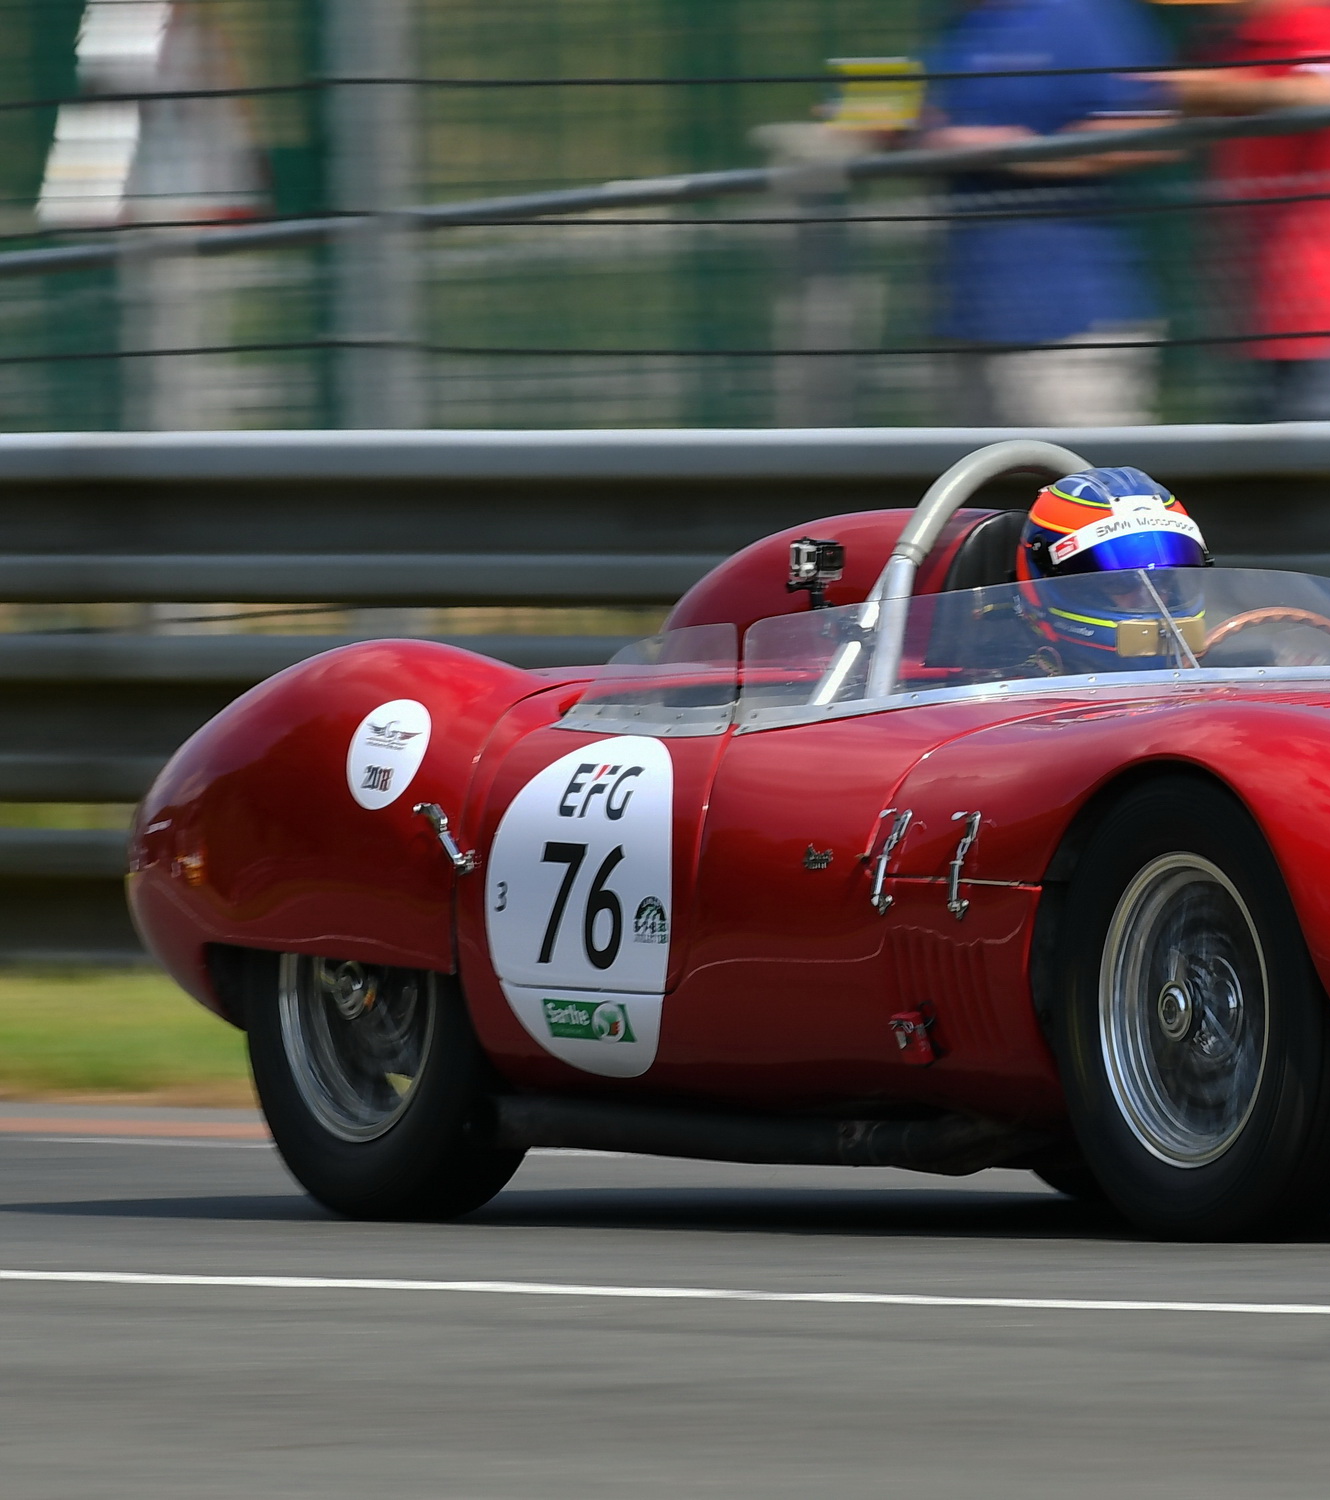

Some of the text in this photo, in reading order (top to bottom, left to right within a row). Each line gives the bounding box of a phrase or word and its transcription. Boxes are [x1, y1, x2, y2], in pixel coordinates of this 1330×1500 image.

[557, 763, 646, 821] EFG
[494, 881, 509, 912] 3
[536, 841, 625, 970] 76
[546, 1002, 590, 1026] Sarthe
